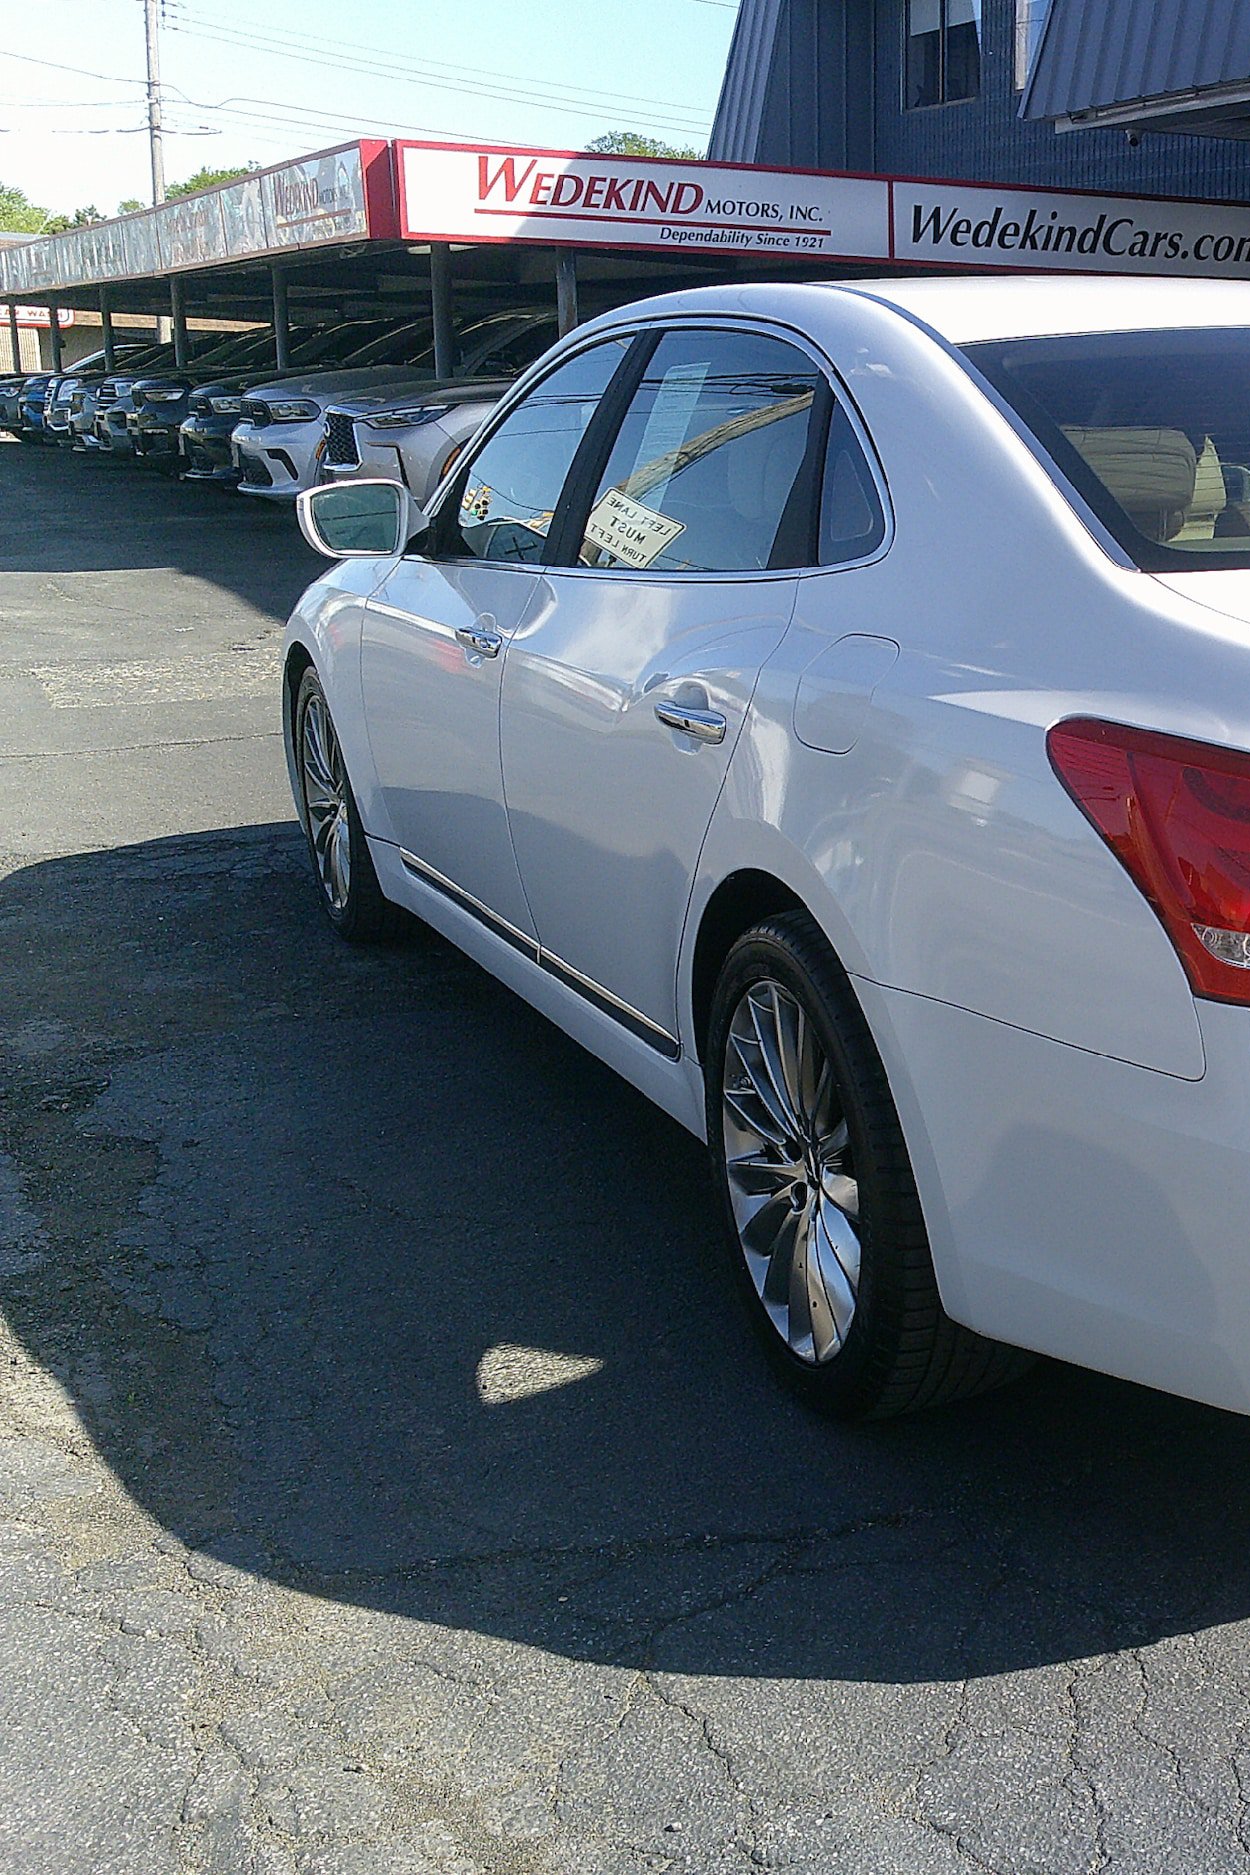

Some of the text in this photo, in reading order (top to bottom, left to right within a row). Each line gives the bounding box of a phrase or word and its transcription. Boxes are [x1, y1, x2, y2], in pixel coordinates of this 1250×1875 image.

[478, 156, 824, 222] WEDEKIND MOTORS, INC.
[660, 227, 825, 248] Dependability Since 1921
